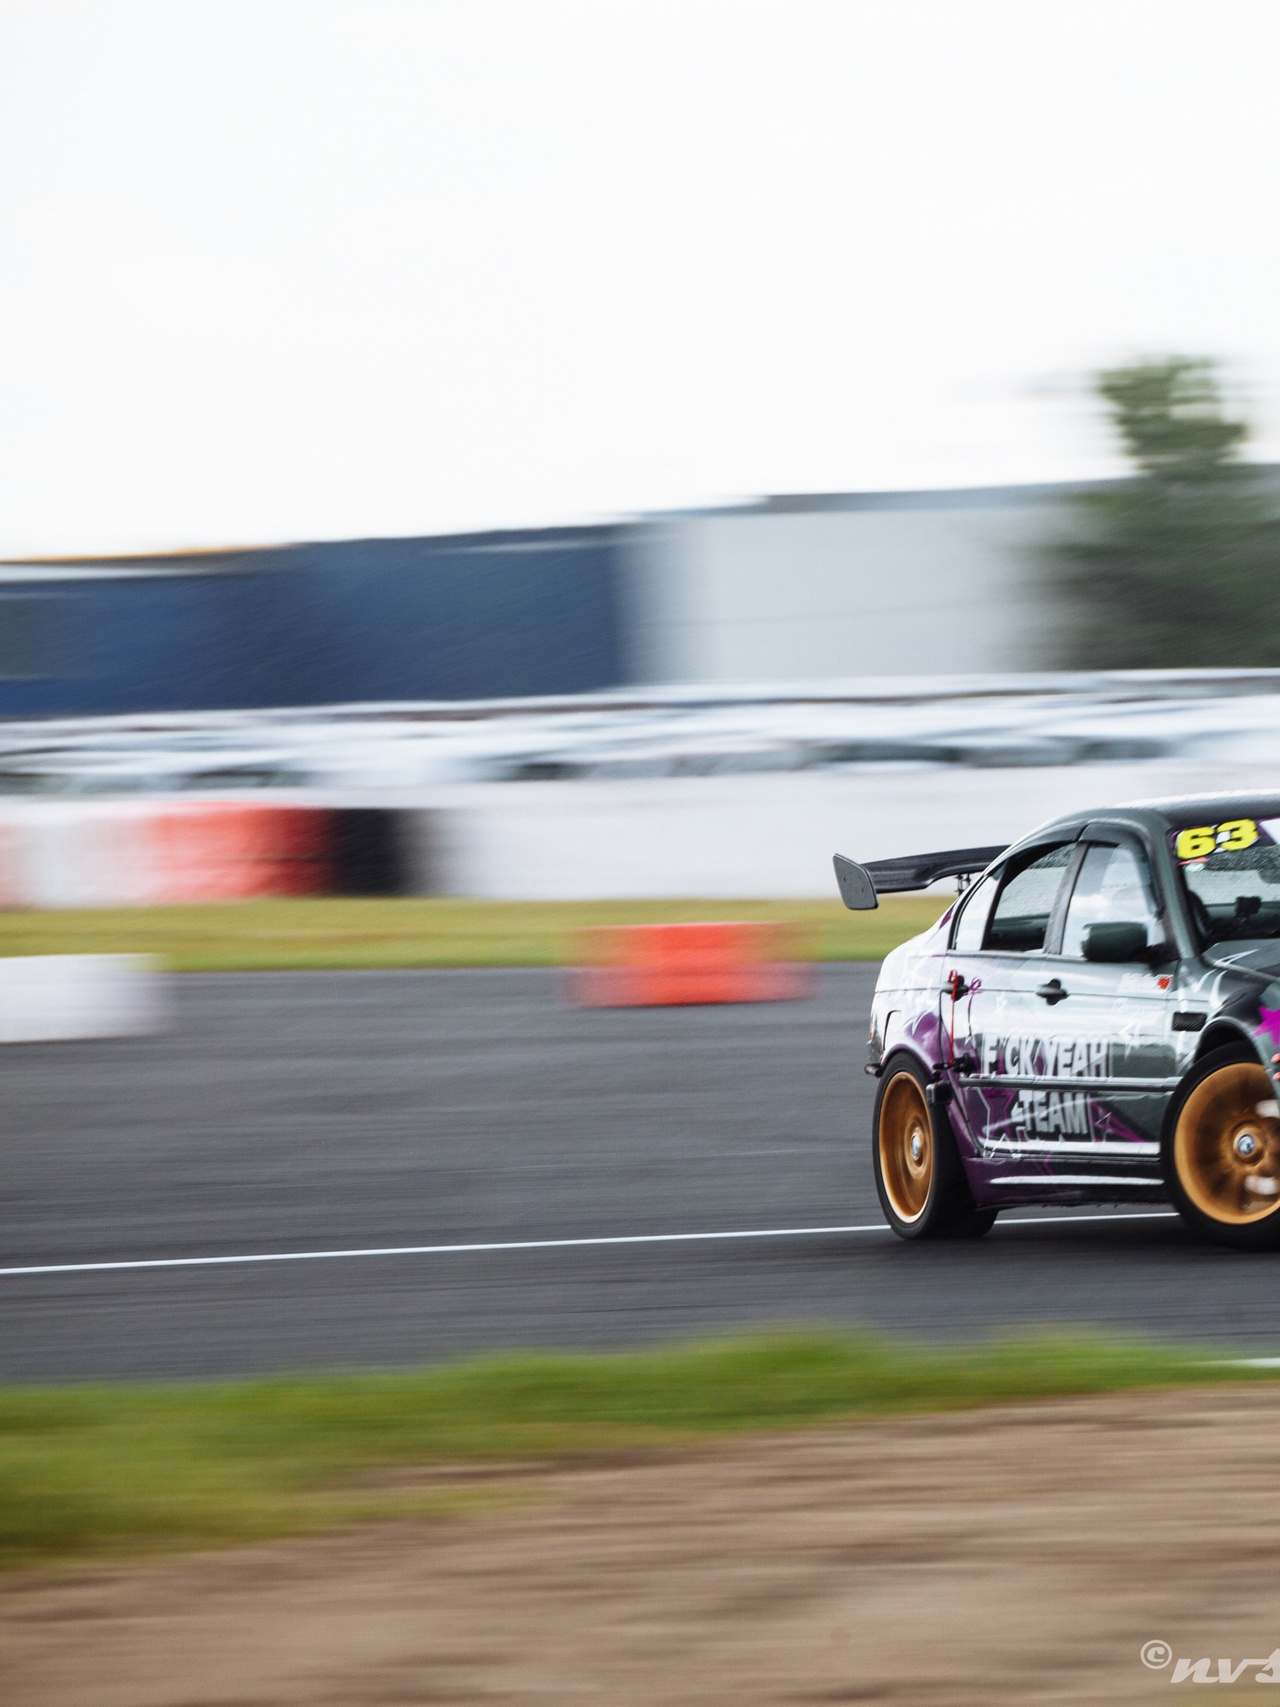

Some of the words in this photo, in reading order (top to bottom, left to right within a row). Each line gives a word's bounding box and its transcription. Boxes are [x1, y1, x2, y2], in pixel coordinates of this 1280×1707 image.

[1176, 819, 1259, 859] 63
[1041, 1036, 1110, 1078] YEAH
[1015, 1088, 1089, 1134] TEAM
